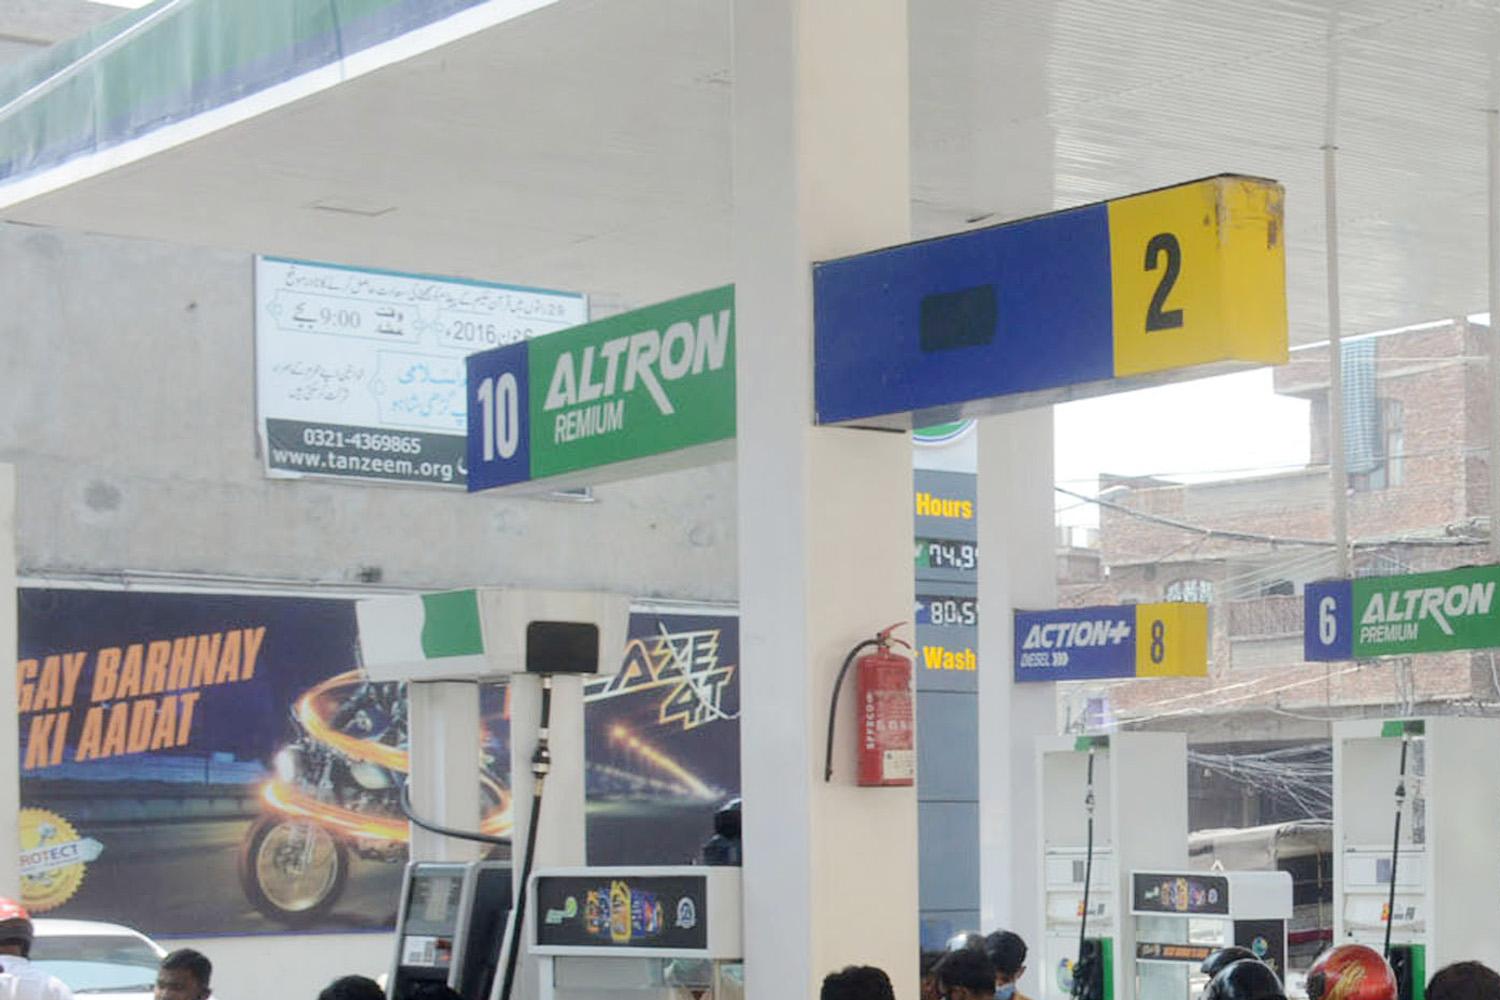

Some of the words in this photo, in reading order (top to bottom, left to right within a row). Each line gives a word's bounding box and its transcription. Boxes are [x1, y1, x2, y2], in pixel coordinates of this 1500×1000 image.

[1143, 232, 1183, 334] 2
[320, 307, 361, 328] 9:00
[478, 372, 519, 461] 10
[543, 309, 730, 415] ALTRON
[555, 399, 624, 444] REMIUM
[303, 427, 421, 454] 0321-4369865
[272, 447, 453, 480] www.tanzeem.org
[916, 493, 973, 519] Hours
[929, 544, 978, 568] 74.9
[931, 601, 978, 625] 80.5
[1319, 596, 1337, 645] 6
[1360, 581, 1496, 635] ALTRON
[1150, 619, 1165, 664] 8
[1360, 622, 1418, 643] PREMIUM
[91, 626, 266, 702] BARHNAY
[923, 645, 976, 670] Wash
[24, 711, 71, 770] KI
[75, 692, 200, 762] AADAT
[19, 843, 78, 866] ROTECT
